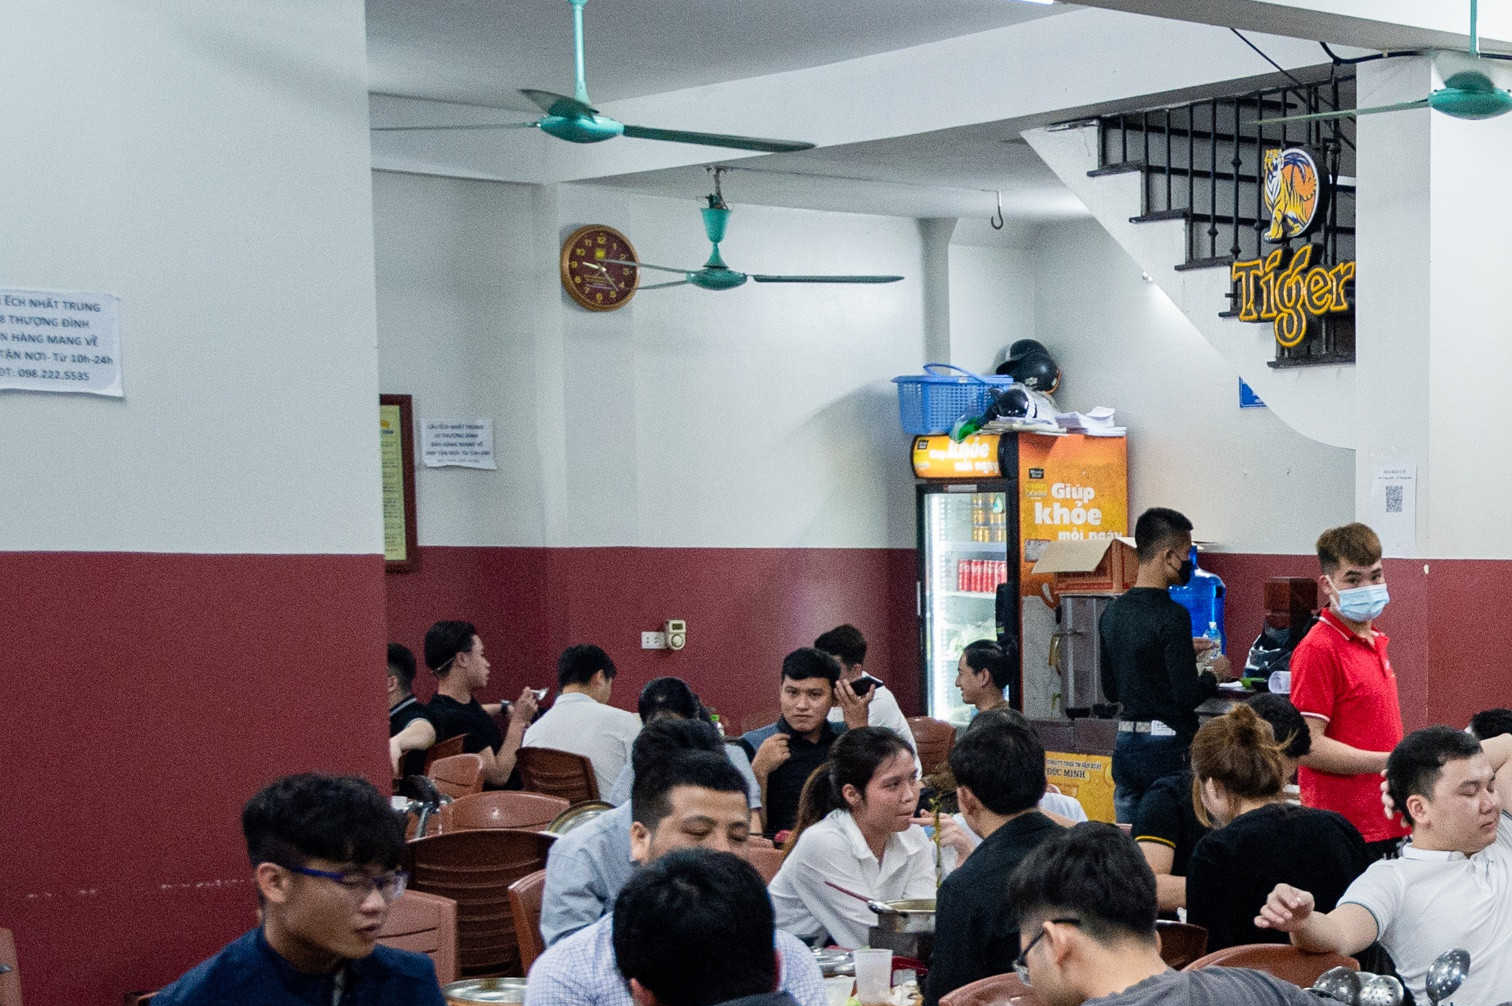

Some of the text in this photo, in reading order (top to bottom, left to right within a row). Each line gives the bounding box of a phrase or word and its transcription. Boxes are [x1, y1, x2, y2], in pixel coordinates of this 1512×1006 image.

[1232, 243, 1356, 348] Tiger
[62, 301, 101, 312] TRUNG
[12, 331, 44, 344] HÀNG
[47, 335, 82, 346] MANG
[71, 354, 114, 365] 10h-24h
[17, 369, 90, 381] 098.222.5535
[1051, 482, 1095, 504] Giúp
[1034, 500, 1102, 525] khỏe
[1064, 769, 1085, 778] MINH
